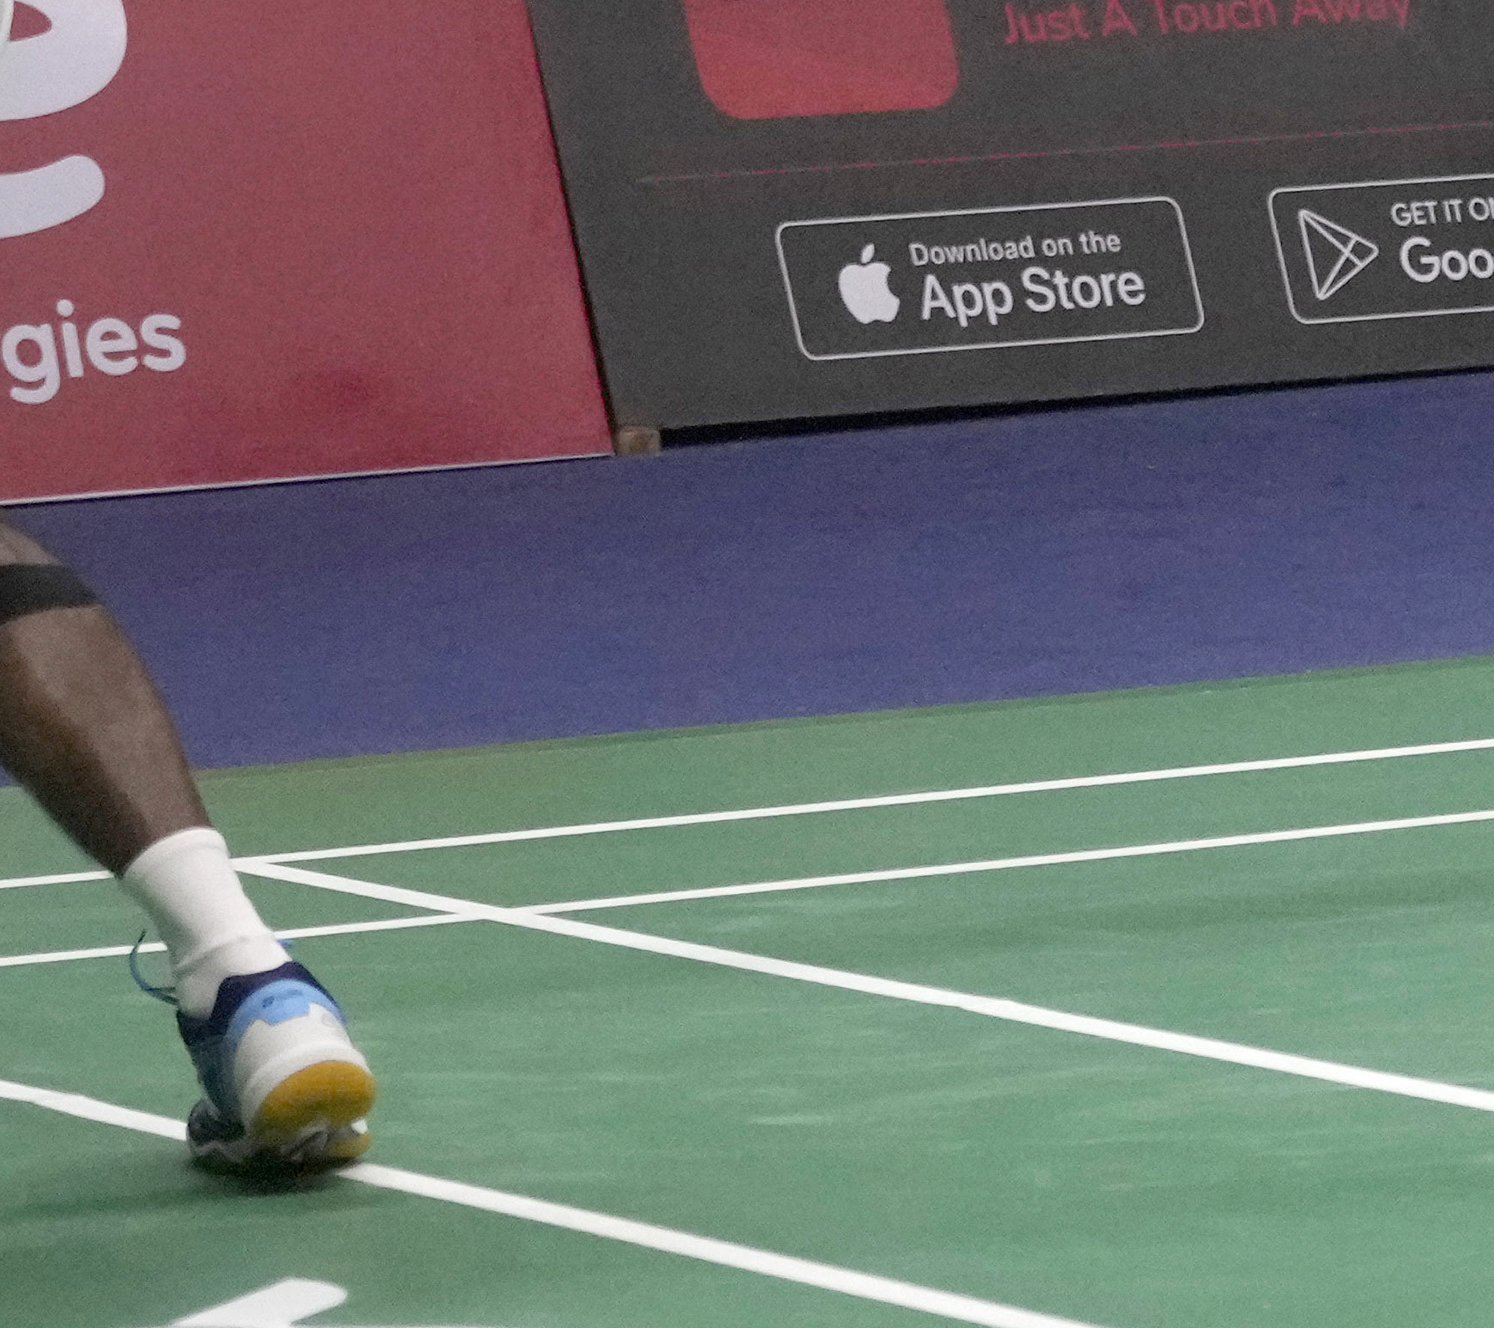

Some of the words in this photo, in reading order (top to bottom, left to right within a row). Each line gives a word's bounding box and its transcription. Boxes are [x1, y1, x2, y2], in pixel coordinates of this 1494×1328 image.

[1004, 1, 1091, 45] Just
[1390, 200, 1438, 227] GET
[1443, 198, 1463, 223] IT
[909, 233, 1035, 267] Download
[1042, 237, 1073, 258] on
[1078, 230, 1121, 254] the
[921, 274, 1013, 327] App
[1021, 265, 1146, 313] Store
